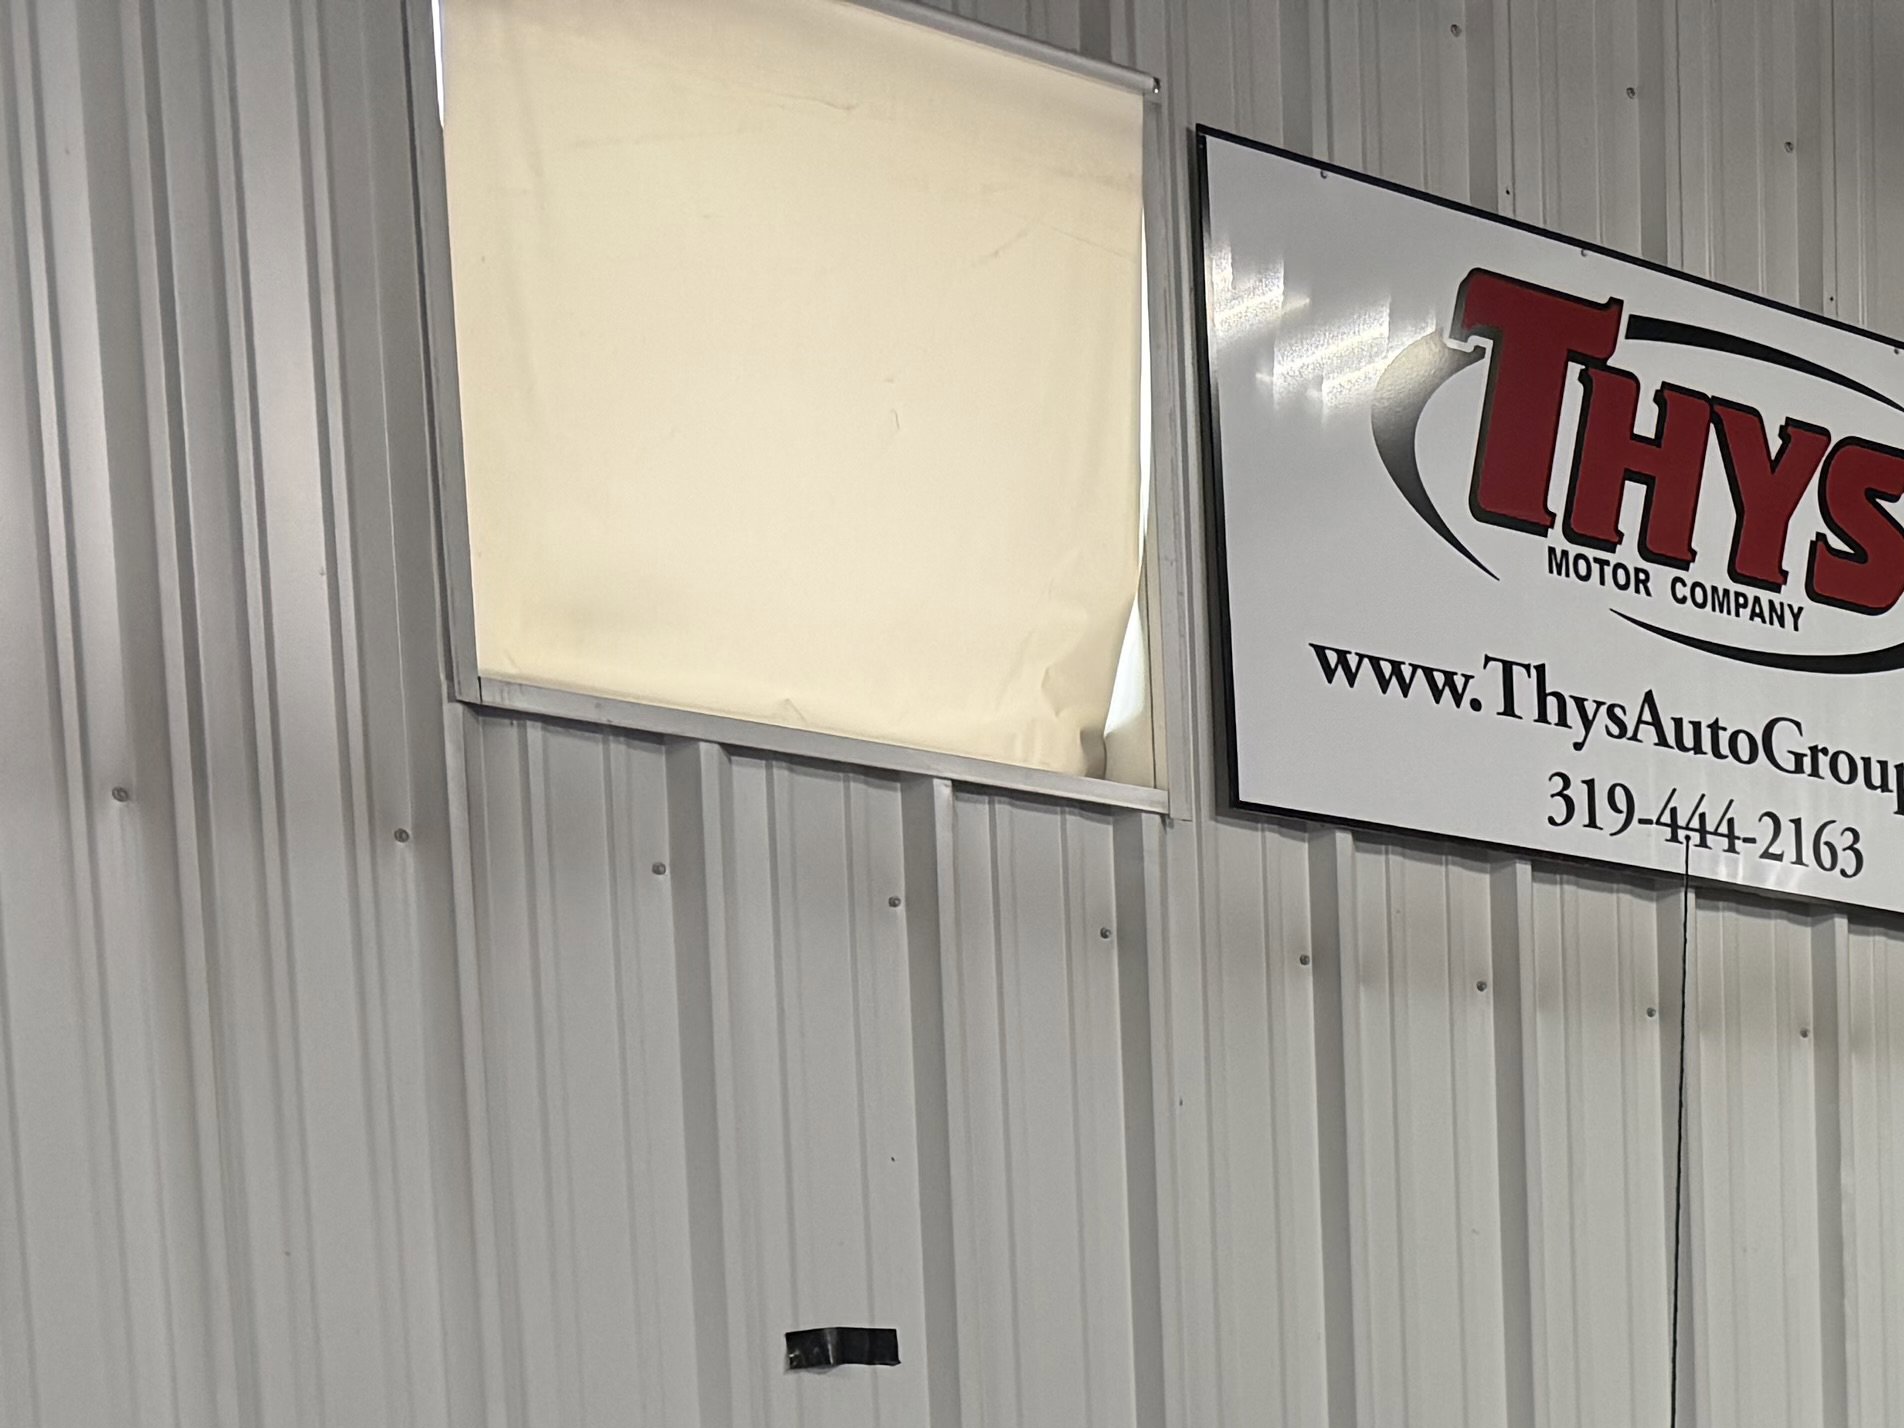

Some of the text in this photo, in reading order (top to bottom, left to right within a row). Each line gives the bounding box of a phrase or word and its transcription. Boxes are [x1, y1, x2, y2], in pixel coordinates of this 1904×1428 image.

[1546, 545, 1805, 633] MOTOR COMPANY
[1545, 770, 1865, 880] 319-444-2163
